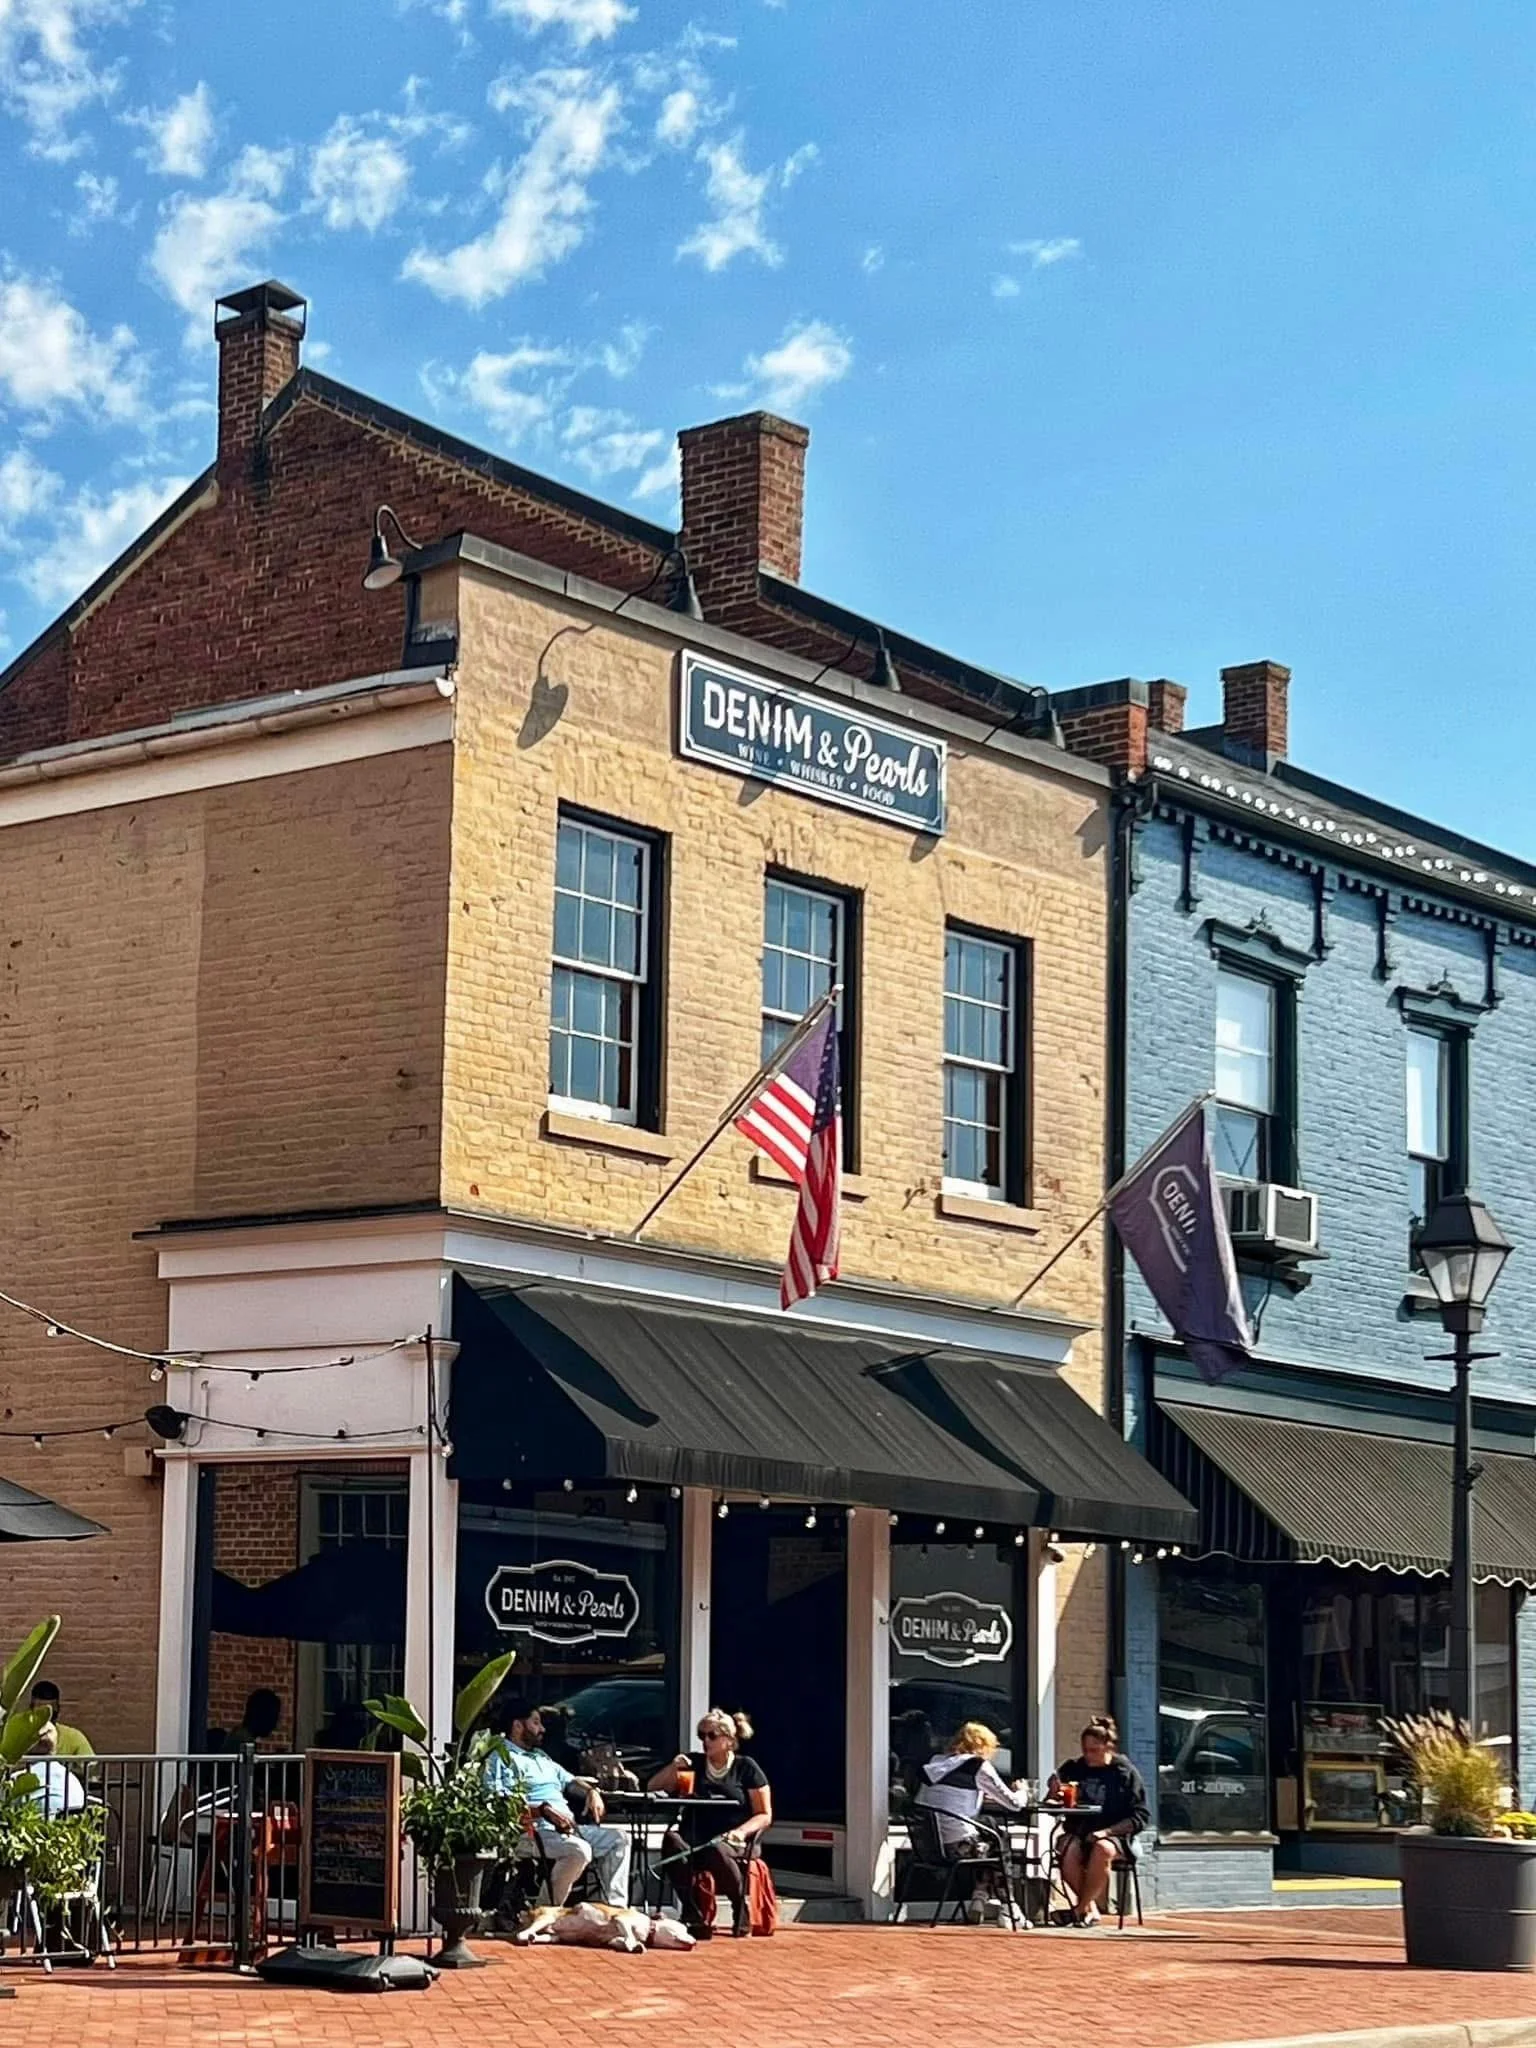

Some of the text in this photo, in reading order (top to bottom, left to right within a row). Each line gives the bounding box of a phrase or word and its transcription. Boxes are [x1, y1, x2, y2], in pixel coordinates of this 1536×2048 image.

[703, 679, 930, 798] DENIM & Pearls
[737, 743, 896, 806] WINE WHISKEY FOOD
[502, 1587, 625, 1619] DENIM & Pearls
[902, 1616, 949, 1641] DENIM
[950, 1622, 962, 1642] &
